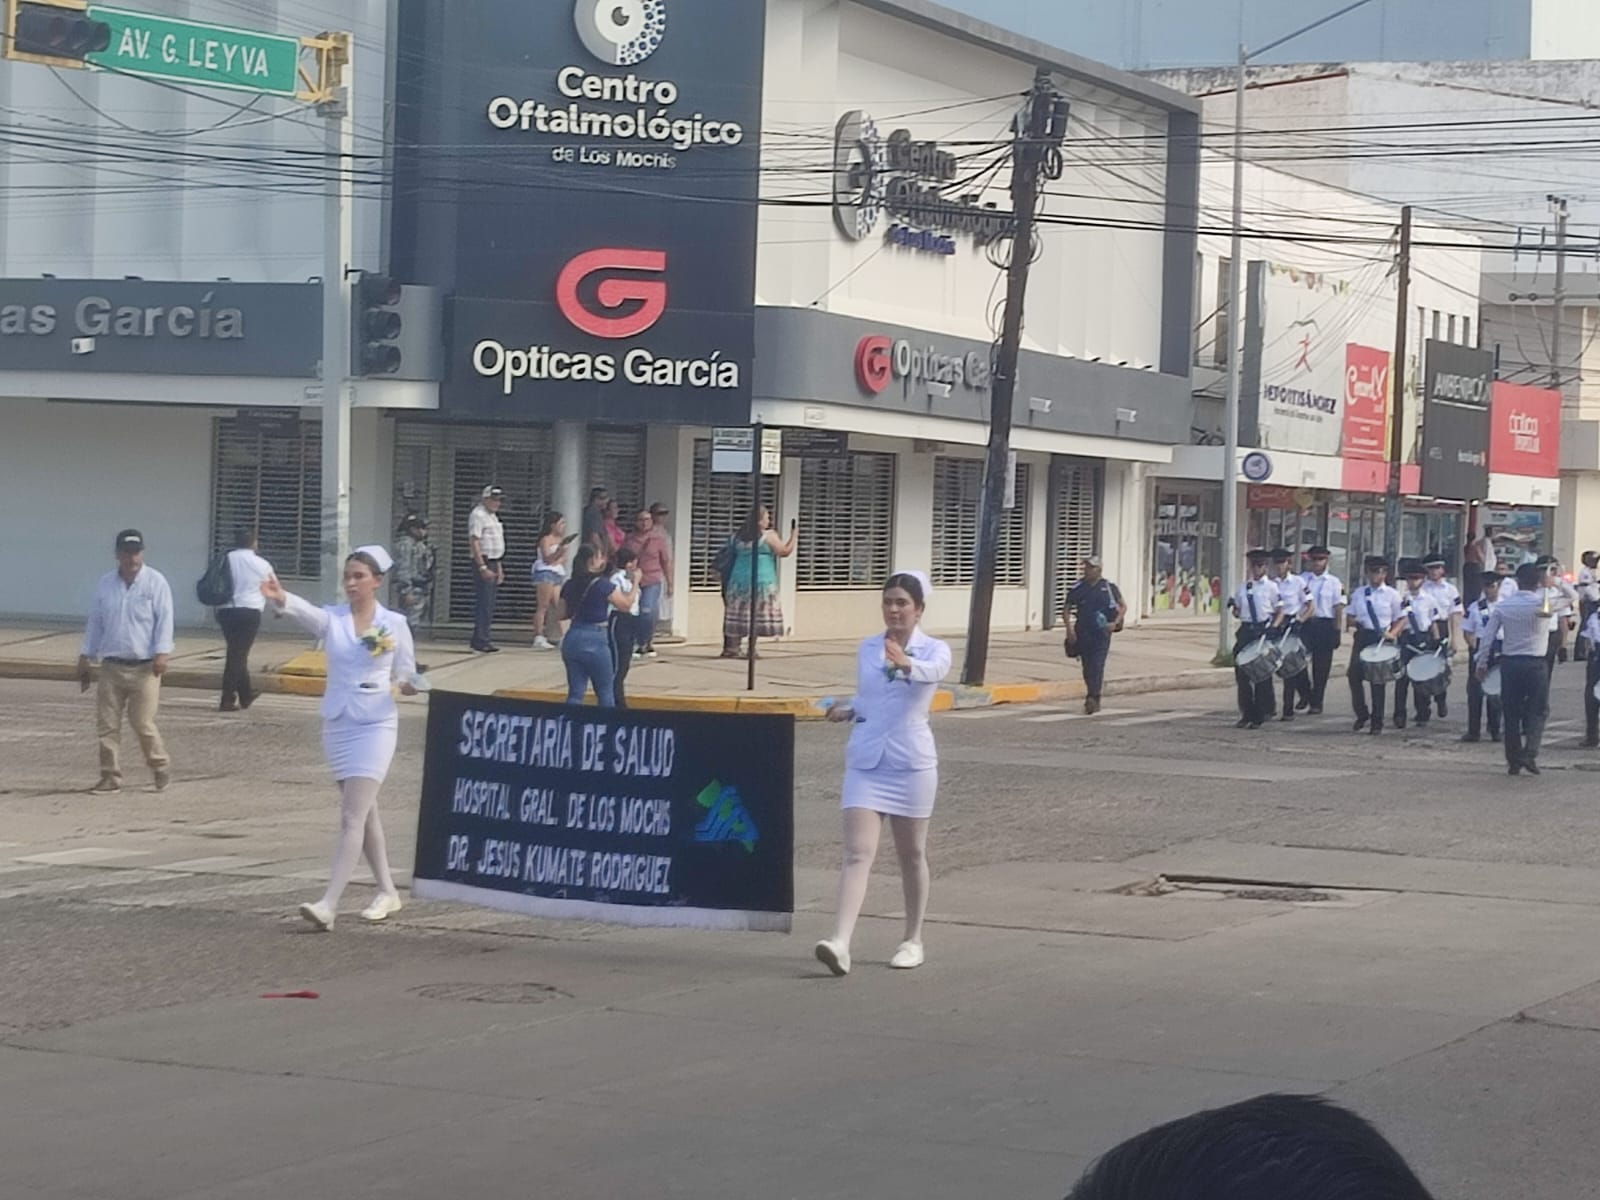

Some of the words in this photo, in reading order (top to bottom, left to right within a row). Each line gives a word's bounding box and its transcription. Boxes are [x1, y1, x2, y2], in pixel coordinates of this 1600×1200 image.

[118, 28, 150, 59] AV.
[162, 34, 180, 64] G.
[189, 38, 270, 77] LEYVA
[557, 65, 678, 105] Centro
[488, 96, 743, 150] Oftalmológico
[551, 146, 574, 162] de
[579, 145, 611, 164] Los
[616, 149, 677, 169] Mochis
[0, 305, 56, 335] as
[75, 292, 244, 339] García
[473, 340, 615, 394] Opticas
[623, 349, 738, 388] García
[893, 339, 964, 394] Opticas
[458, 709, 573, 770] SECRETARÍA
[581, 723, 607, 772] DE
[615, 726, 675, 777] SALUD
[452, 778, 511, 819] HOSPITAL
[520, 788, 559, 826] GRAL.
[566, 793, 585, 828] DE
[589, 796, 616, 832] LOS
[621, 797, 671, 836] MOCHIS
[447, 835, 471, 872] DR.
[477, 839, 520, 876] JESUS
[524, 843, 585, 886] KUMATE
[590, 852, 673, 894] RODRIGUEZ
